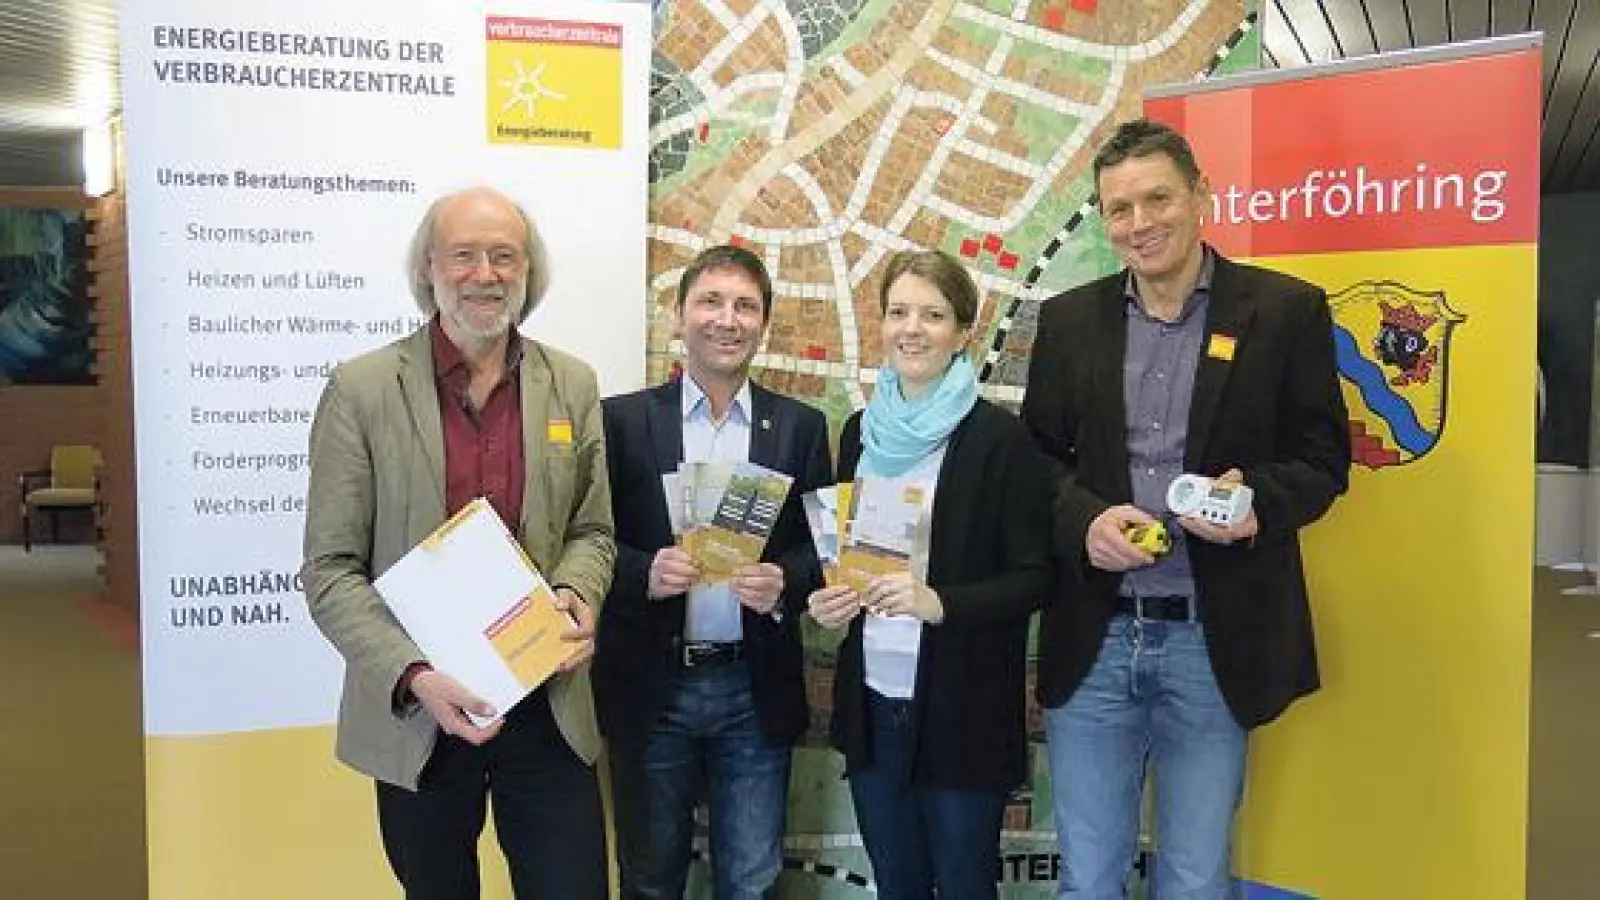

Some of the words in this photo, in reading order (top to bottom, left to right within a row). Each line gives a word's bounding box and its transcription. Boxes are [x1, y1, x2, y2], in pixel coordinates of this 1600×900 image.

[153, 25, 390, 61] ENERGIEBERATUNG
[399, 39, 444, 63] DER
[153, 59, 456, 97] VERBRAUCHERZENTRALE
[157, 168, 229, 188] Unsere
[234, 170, 417, 195] Beratungsthemen:
[186, 222, 315, 245] Stromsparen
[188, 269, 255, 289] Heizen
[262, 271, 299, 289] und
[305, 271, 366, 290] Lüften
[188, 314, 283, 334] Baulicher
[287, 315, 361, 334] Wärme-
[367, 317, 403, 335] und
[189, 361, 287, 383] Heizungs-
[294, 360, 331, 378] und
[191, 405, 311, 424] Erneuerbare
[194, 495, 276, 515] Wechsel
[170, 605, 224, 627] UND
[231, 602, 290, 626] NAH.
